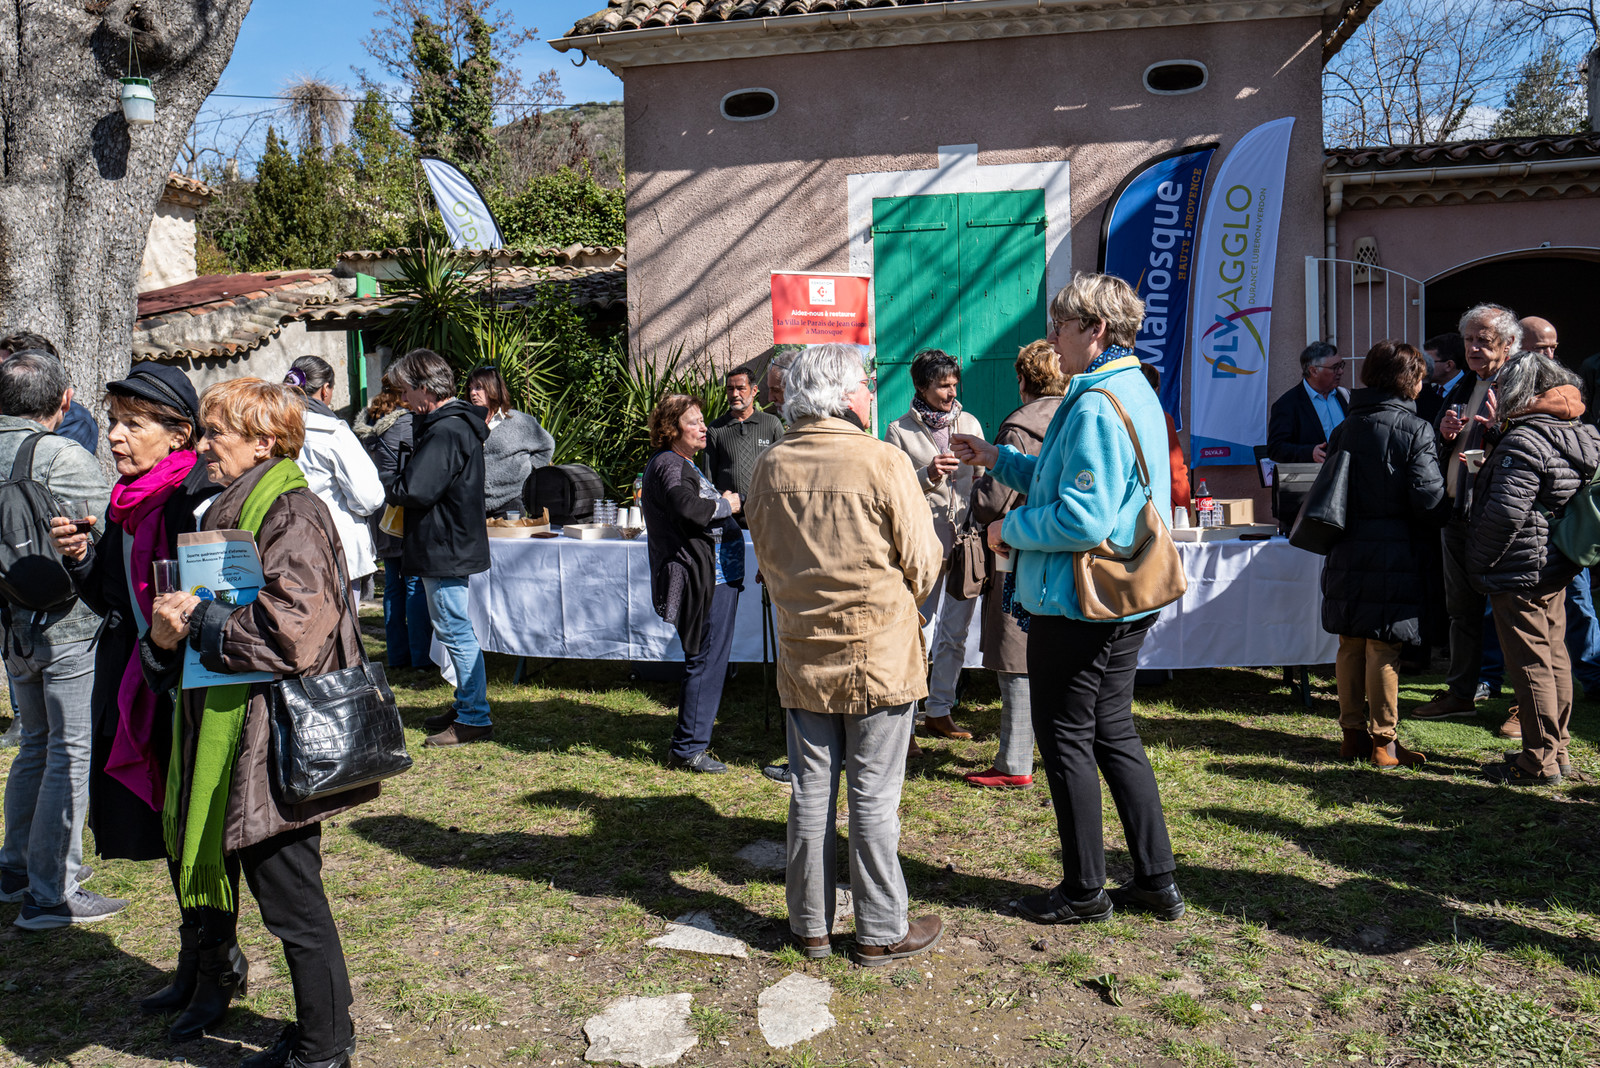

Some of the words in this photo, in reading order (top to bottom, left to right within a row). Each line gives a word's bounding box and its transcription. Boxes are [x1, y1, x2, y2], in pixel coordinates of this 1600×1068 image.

[1256, 187, 1267, 223] VERDON
[1178, 240, 1190, 280] HAUTE
[1184, 168, 1202, 228] PROVENCE
[1252, 224, 1262, 263] LUBERON
[1134, 181, 1187, 373] Manosque
[1248, 265, 1259, 304] DURANCE
[791, 309, 824, 317] Aidez-nous
[836, 320, 850, 328] Jean
[810, 328, 843, 336] Manosque
